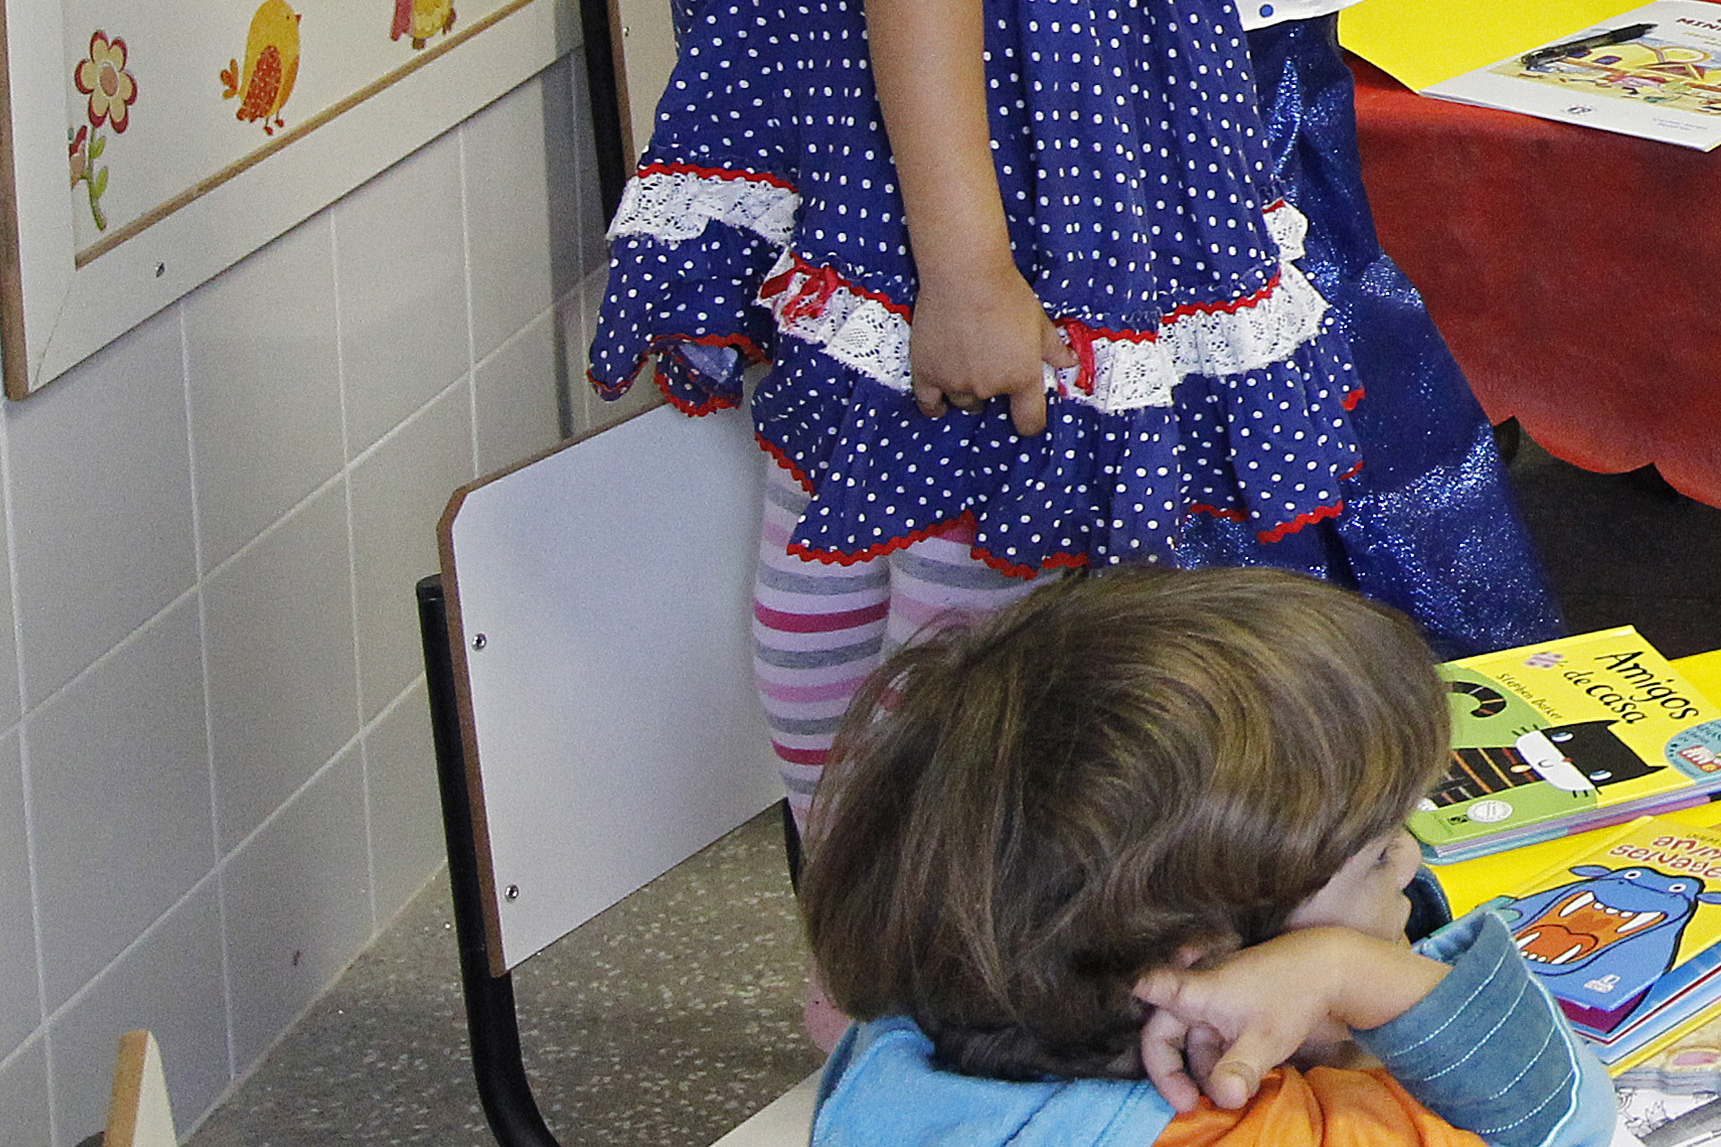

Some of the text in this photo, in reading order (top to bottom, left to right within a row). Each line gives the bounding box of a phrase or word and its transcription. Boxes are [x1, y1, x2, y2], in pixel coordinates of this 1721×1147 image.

[1563, 671, 1647, 724] de casa
[1594, 650, 1699, 720] Amigos
